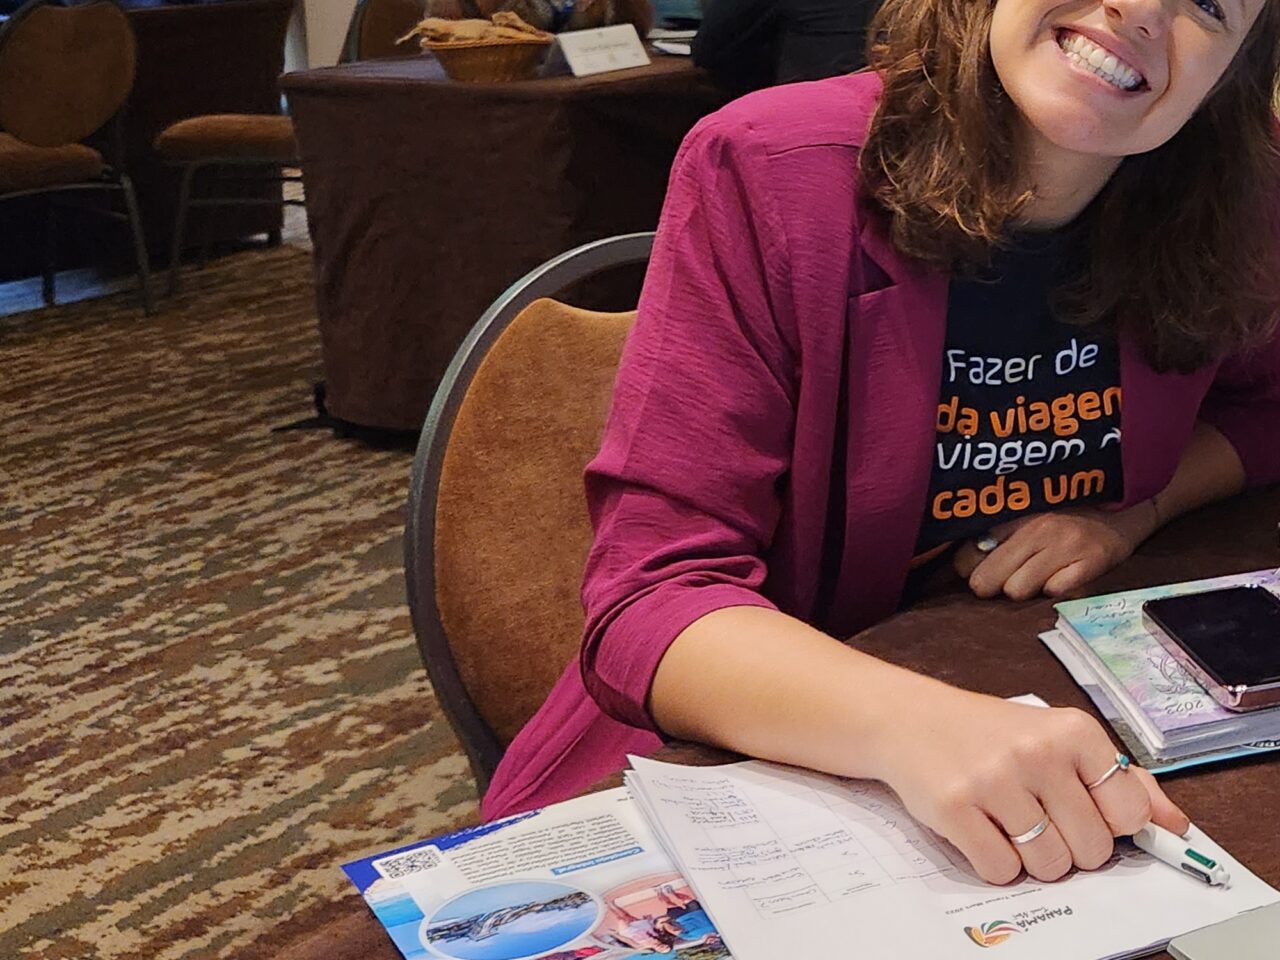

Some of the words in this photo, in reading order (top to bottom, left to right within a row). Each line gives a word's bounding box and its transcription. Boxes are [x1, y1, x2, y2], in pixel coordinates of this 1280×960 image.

[946, 348, 1042, 385] Fazer
[1055, 338, 1099, 375] de
[937, 435, 1086, 474] viagem
[932, 475, 1031, 520] cada
[1043, 468, 1105, 504] um
[1015, 905, 1074, 933] PANAMÁ
